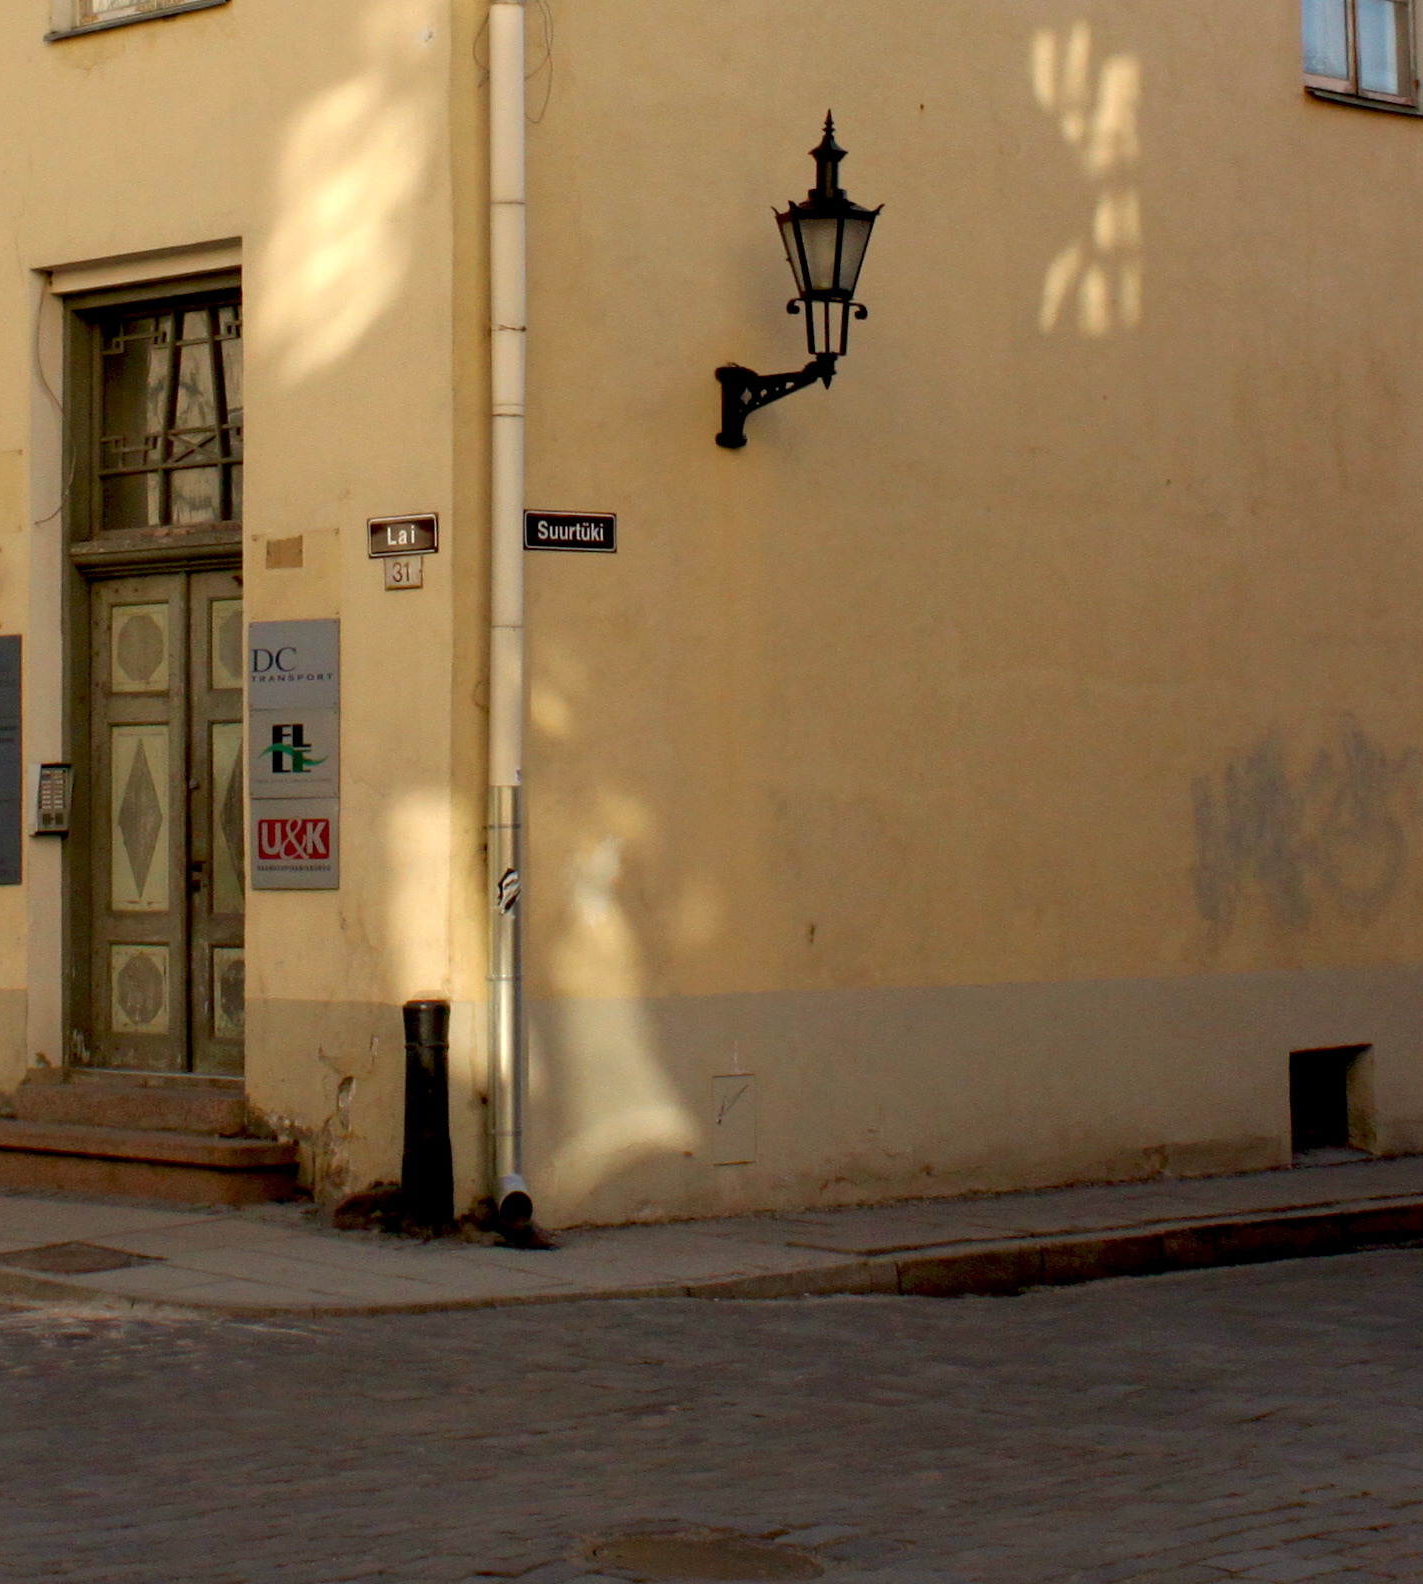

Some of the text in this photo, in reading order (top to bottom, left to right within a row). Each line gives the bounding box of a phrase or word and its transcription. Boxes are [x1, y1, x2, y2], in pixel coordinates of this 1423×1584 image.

[387, 524, 416, 546] Lai
[538, 520, 605, 541] Suurtüki
[392, 562, 410, 583] 31
[252, 646, 297, 673] DC
[251, 672, 333, 683] TRANSPORT
[261, 818, 328, 860] U&K
